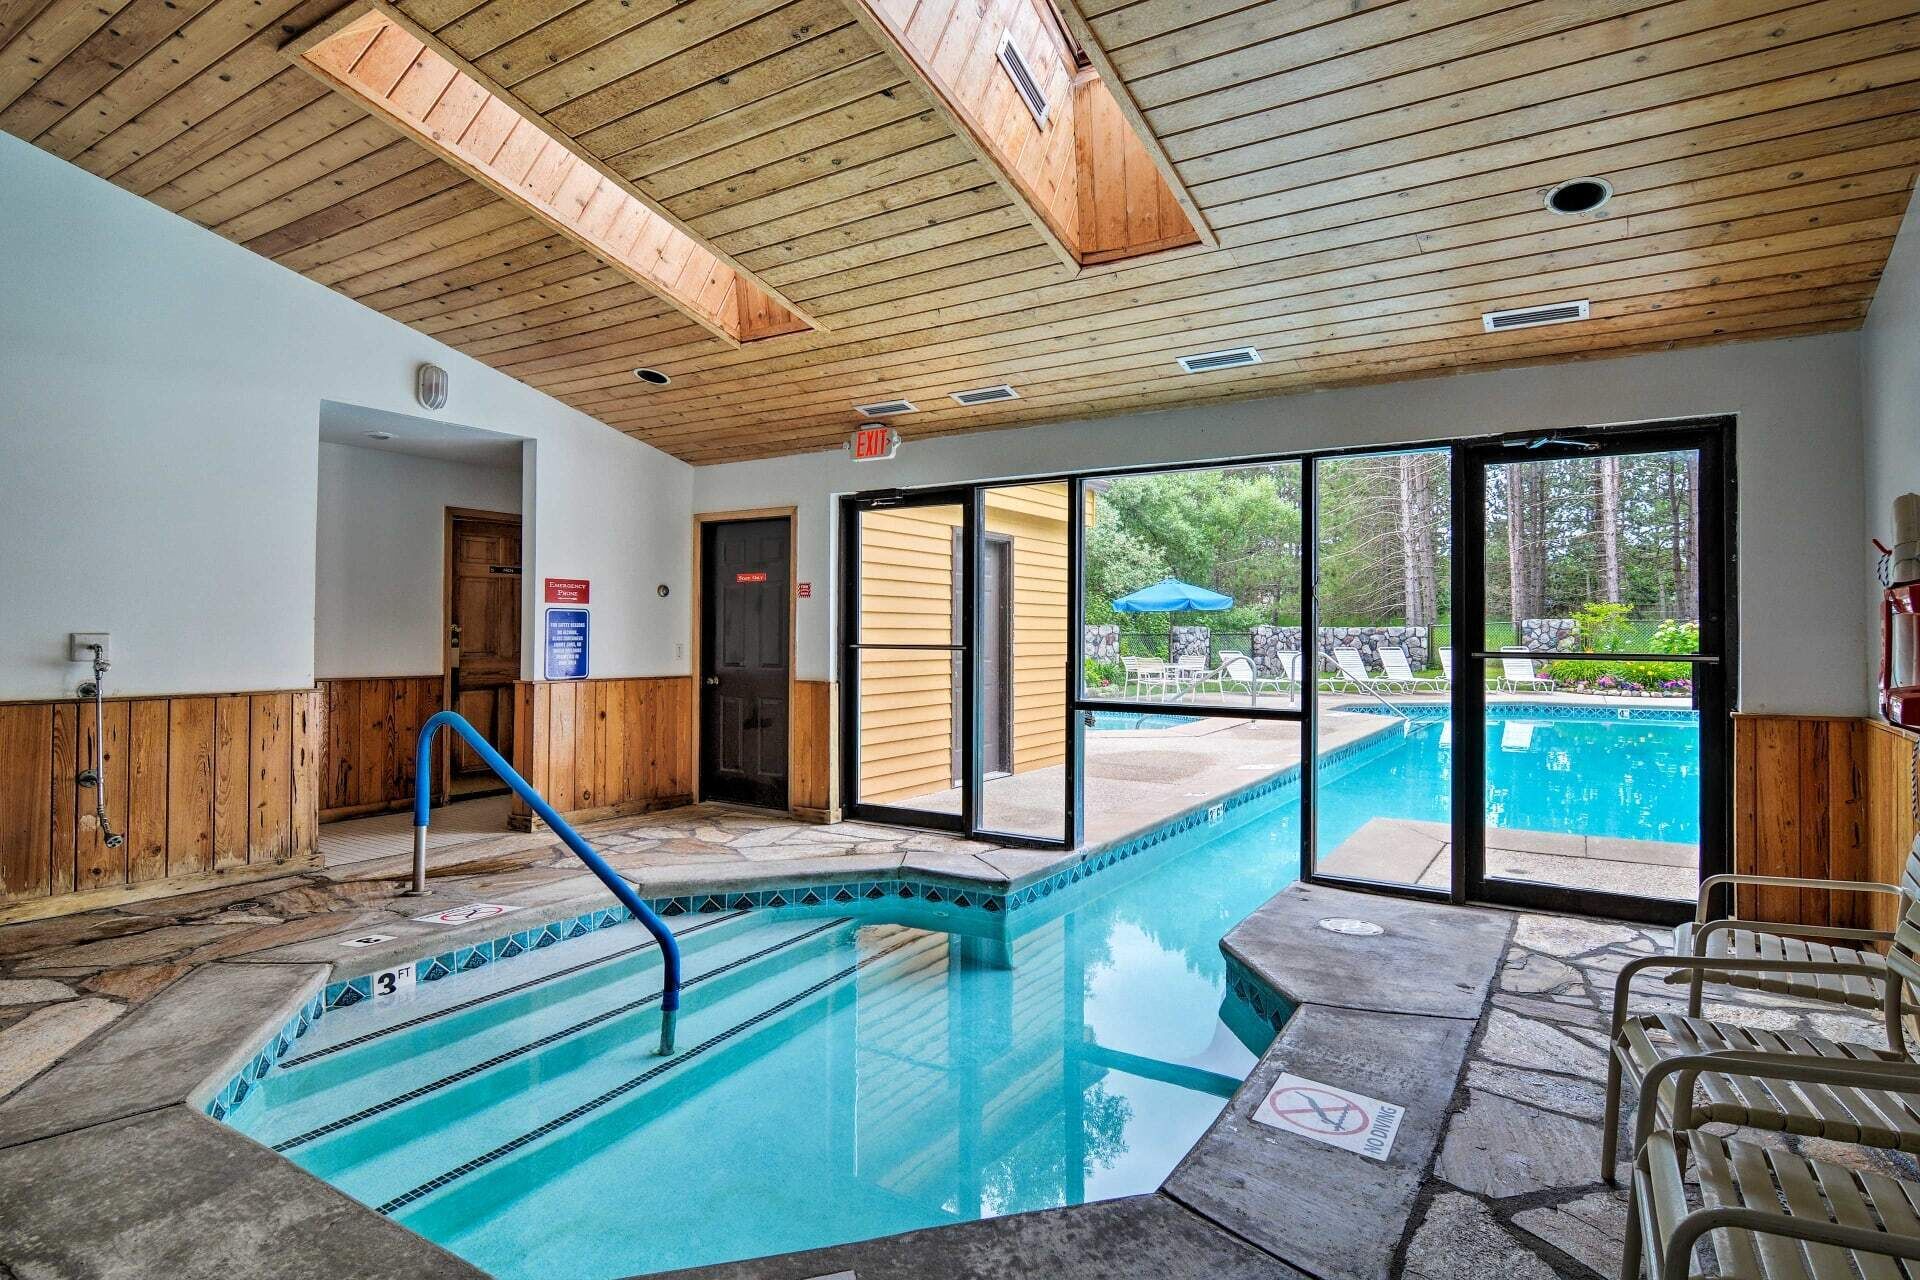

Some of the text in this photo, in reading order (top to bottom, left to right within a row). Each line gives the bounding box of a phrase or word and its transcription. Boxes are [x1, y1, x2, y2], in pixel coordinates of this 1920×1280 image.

[856, 429, 887, 458] EXIT
[549, 581, 587, 589] EMERGENCY
[557, 589, 578, 597] PHONE
[377, 966, 411, 996] 3 FT
[1364, 1105, 1397, 1155] NO DIVING
